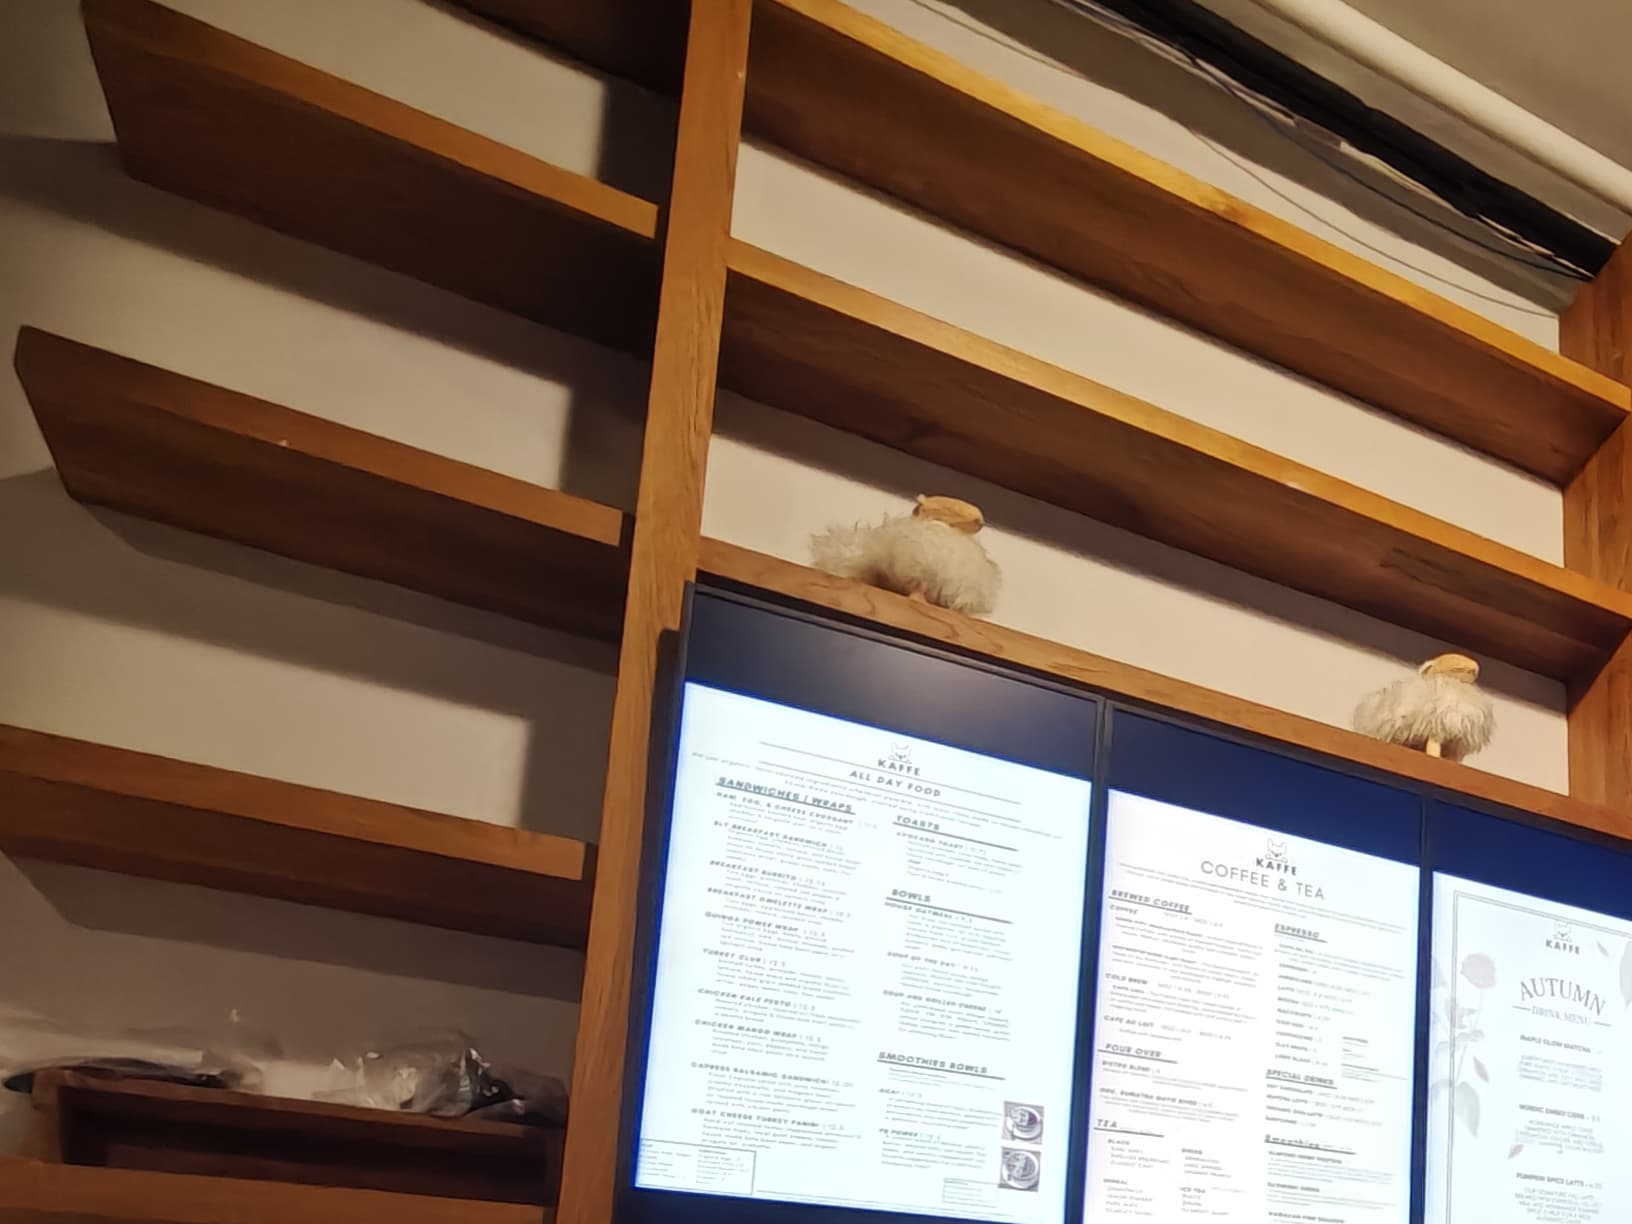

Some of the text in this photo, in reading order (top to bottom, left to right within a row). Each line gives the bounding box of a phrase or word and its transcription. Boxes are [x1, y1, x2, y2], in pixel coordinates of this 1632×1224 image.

[877, 758, 921, 776] KAFFE
[849, 769, 941, 797] ALL DAY FOOD
[718, 776, 799, 800] SANDWICHES
[811, 796, 852, 812] WRAPS
[896, 815, 939, 830] TOASTS
[731, 824, 780, 838] BREAKFAST
[782, 834, 827, 848] SANDWICH
[709, 859, 797, 881] BREAKFAST BURRITO
[1256, 857, 1296, 876] KAFFE
[1200, 859, 1324, 901] COFFEE & TEA
[707, 887, 756, 900] BREAKFAST
[804, 905, 828, 914] WRAP
[891, 888, 931, 902] BOWLS
[1112, 889, 1190, 911] BREWED COFFEE
[775, 924, 798, 932] WRAP
[1274, 923, 1319, 938] ESPRESSO
[1545, 939, 1581, 955] KAFFE
[697, 987, 737, 998] CHICKEN
[1520, 977, 1606, 1016] AUTUMN
[694, 1019, 734, 1029] CHICKEN
[773, 1030, 797, 1038] WRAP
[1105, 1043, 1161, 1058] POUR OVER
[878, 1051, 987, 1073] SMOOTHIES BOWLS
[1267, 1069, 1300, 1080] SPECIAL
[720, 1111, 752, 1120] CHEESE
[1097, 1119, 1117, 1128] TEA
